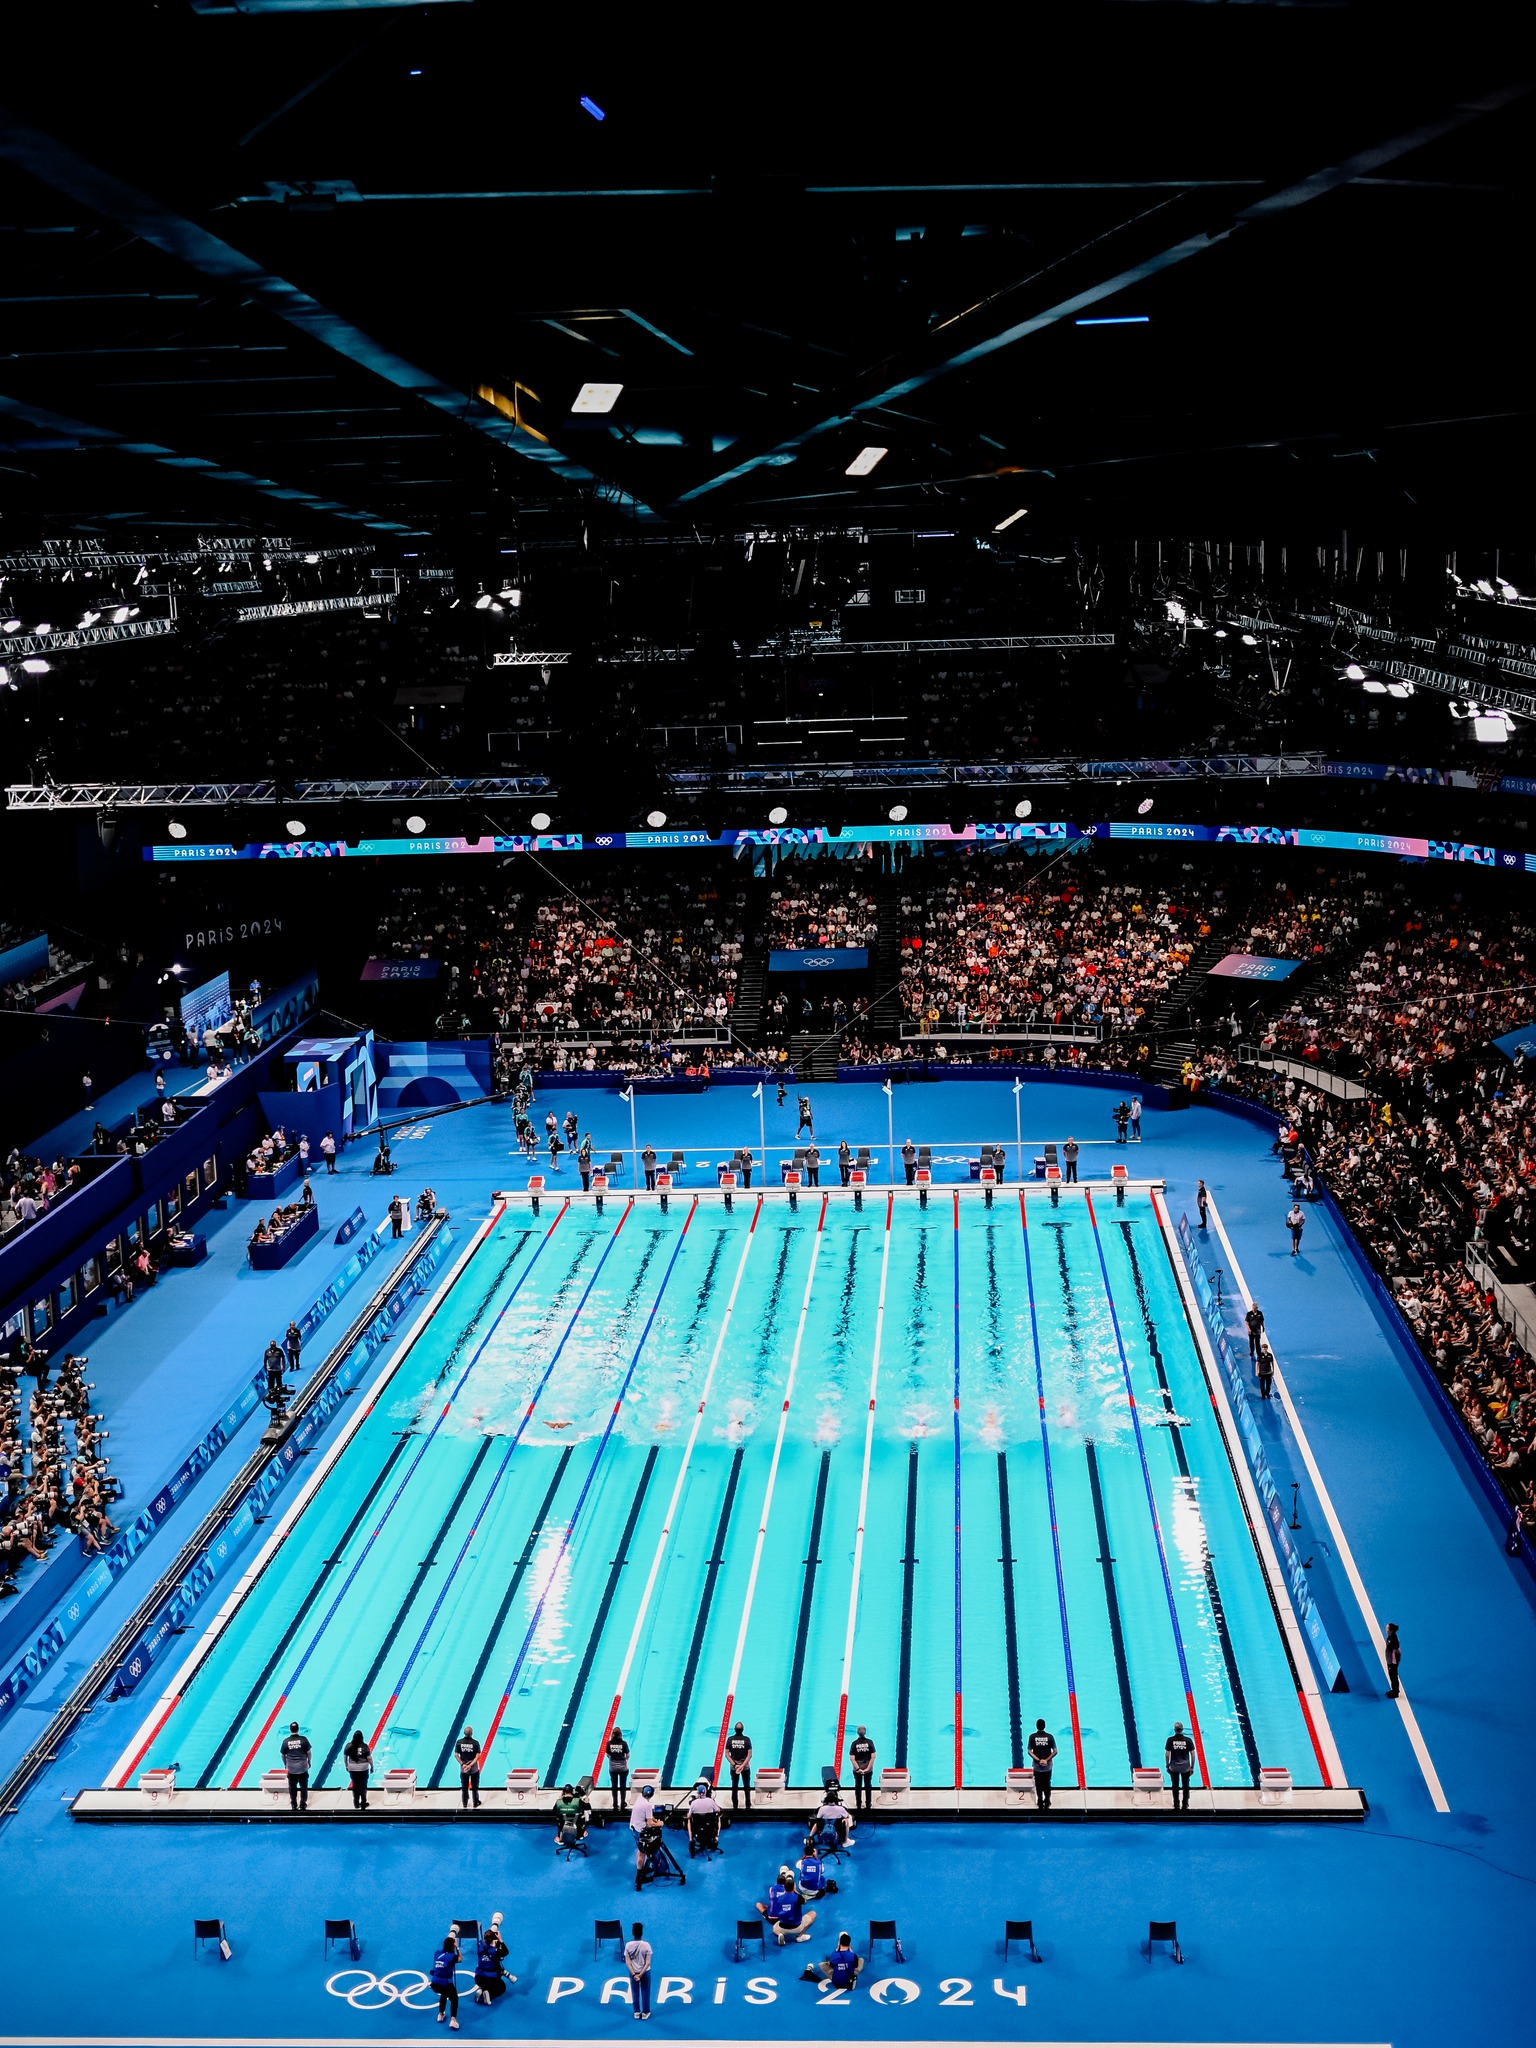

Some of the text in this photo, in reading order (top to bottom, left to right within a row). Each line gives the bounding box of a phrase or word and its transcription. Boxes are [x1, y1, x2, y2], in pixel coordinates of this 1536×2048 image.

[1347, 765, 1373, 775] 2024
[889, 829, 951, 837] PARIS 202
[1131, 827, 1194, 837] PARIS 2024
[647, 835, 679, 844] PARIS
[1358, 837, 1411, 851] PARIS 2024
[409, 841, 472, 850] PARIS 202
[174, 848, 238, 857] PARIS 2024
[240, 918, 282, 939] 2024
[150, 1790, 157, 1801] 9
[272, 1791, 279, 1801] 8
[517, 1790, 524, 1801] 6
[766, 1790, 773, 1800] 4
[891, 1790, 898, 1800] 3
[1018, 1790, 1025, 1800] 2
